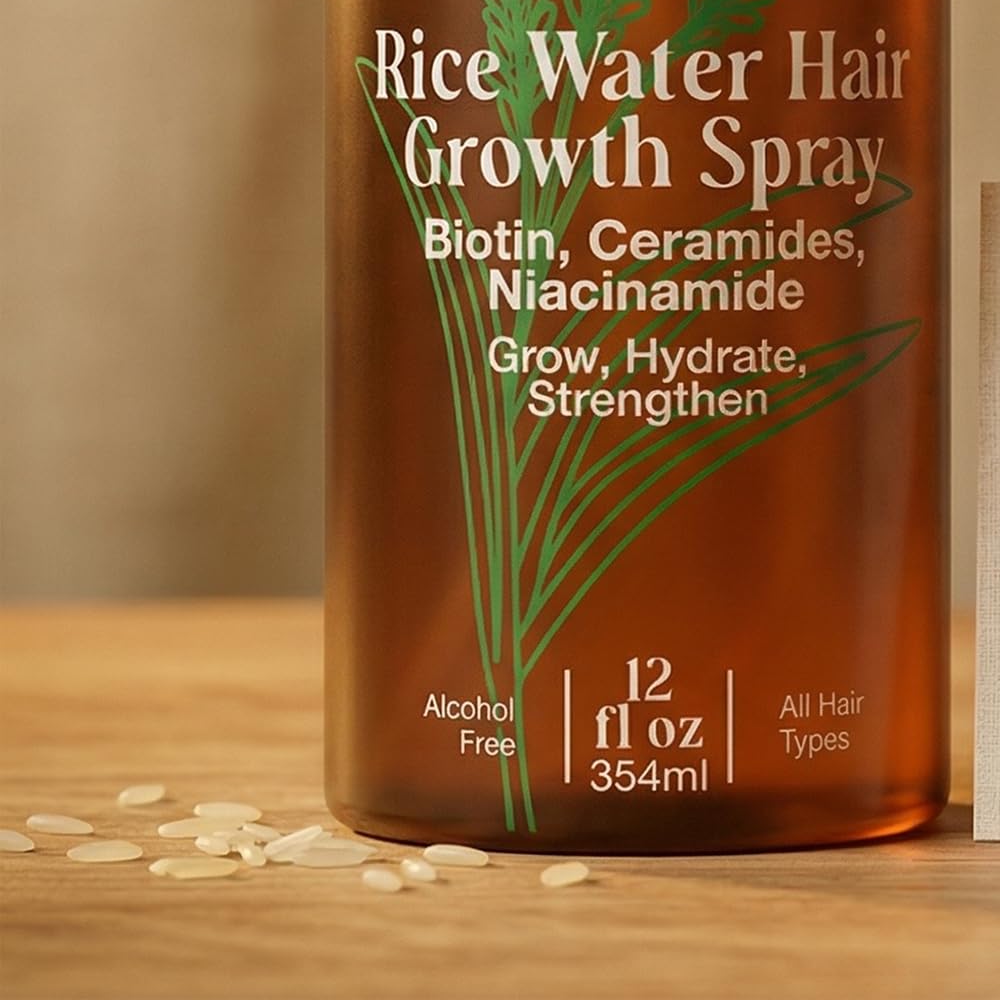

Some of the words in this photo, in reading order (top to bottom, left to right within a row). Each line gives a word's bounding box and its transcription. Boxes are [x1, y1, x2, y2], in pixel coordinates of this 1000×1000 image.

[375, 28, 499, 101] Rice
[526, 30, 763, 101] Water
[788, 27, 911, 101] Hair
[404, 114, 672, 188] Growth
[699, 115, 885, 212] Spray
[424, 217, 570, 268] Biotin,
[588, 218, 867, 267] Ceramides,
[488, 268, 805, 312] Niacinamide
[487, 335, 610, 380] Grow,
[626, 337, 808, 384] Hydrate,
[527, 379, 769, 427] Strengthen
[627, 657, 672, 701] 12
[423, 693, 514, 722] Alcohol
[595, 703, 631, 749] fl
[648, 717, 703, 748] oz
[779, 693, 810, 719] All
[819, 690, 866, 717] Hair
[460, 729, 516, 757] Free
[779, 727, 850, 759] Types
[590, 759, 707, 792] 354ml
